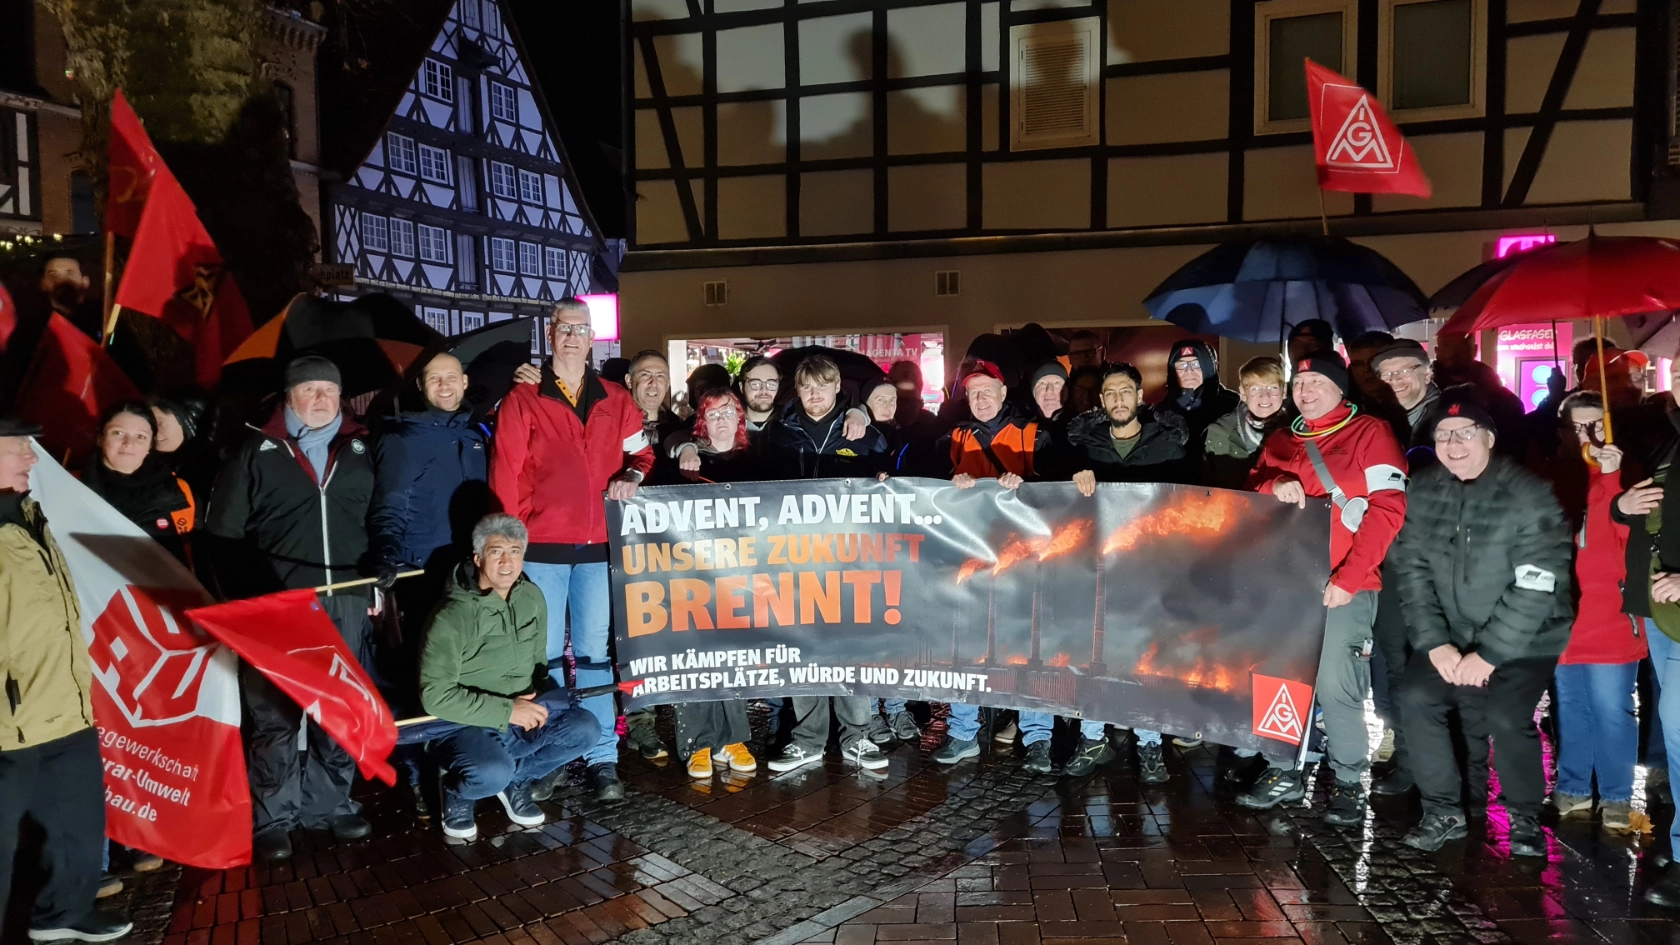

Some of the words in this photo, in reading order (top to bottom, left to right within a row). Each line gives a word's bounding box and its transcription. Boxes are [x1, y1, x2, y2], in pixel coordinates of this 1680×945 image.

[905, 347, 918, 357] TV
[621, 496, 769, 536] ADVENT,
[777, 493, 942, 526] ADVENT...
[622, 536, 758, 575] UNSERE
[767, 532, 925, 565] ZUKUNFT
[625, 569, 902, 638] BRENNT!
[630, 655, 668, 676] WIR
[672, 648, 761, 670] KÄMPFEN
[765, 644, 801, 665] FÜR
[632, 666, 785, 698] ARBEITSPLÄTZE,
[789, 662, 856, 684] WÜRDE
[860, 666, 899, 685] UND
[903, 668, 992, 693] ZUKUNFT.
